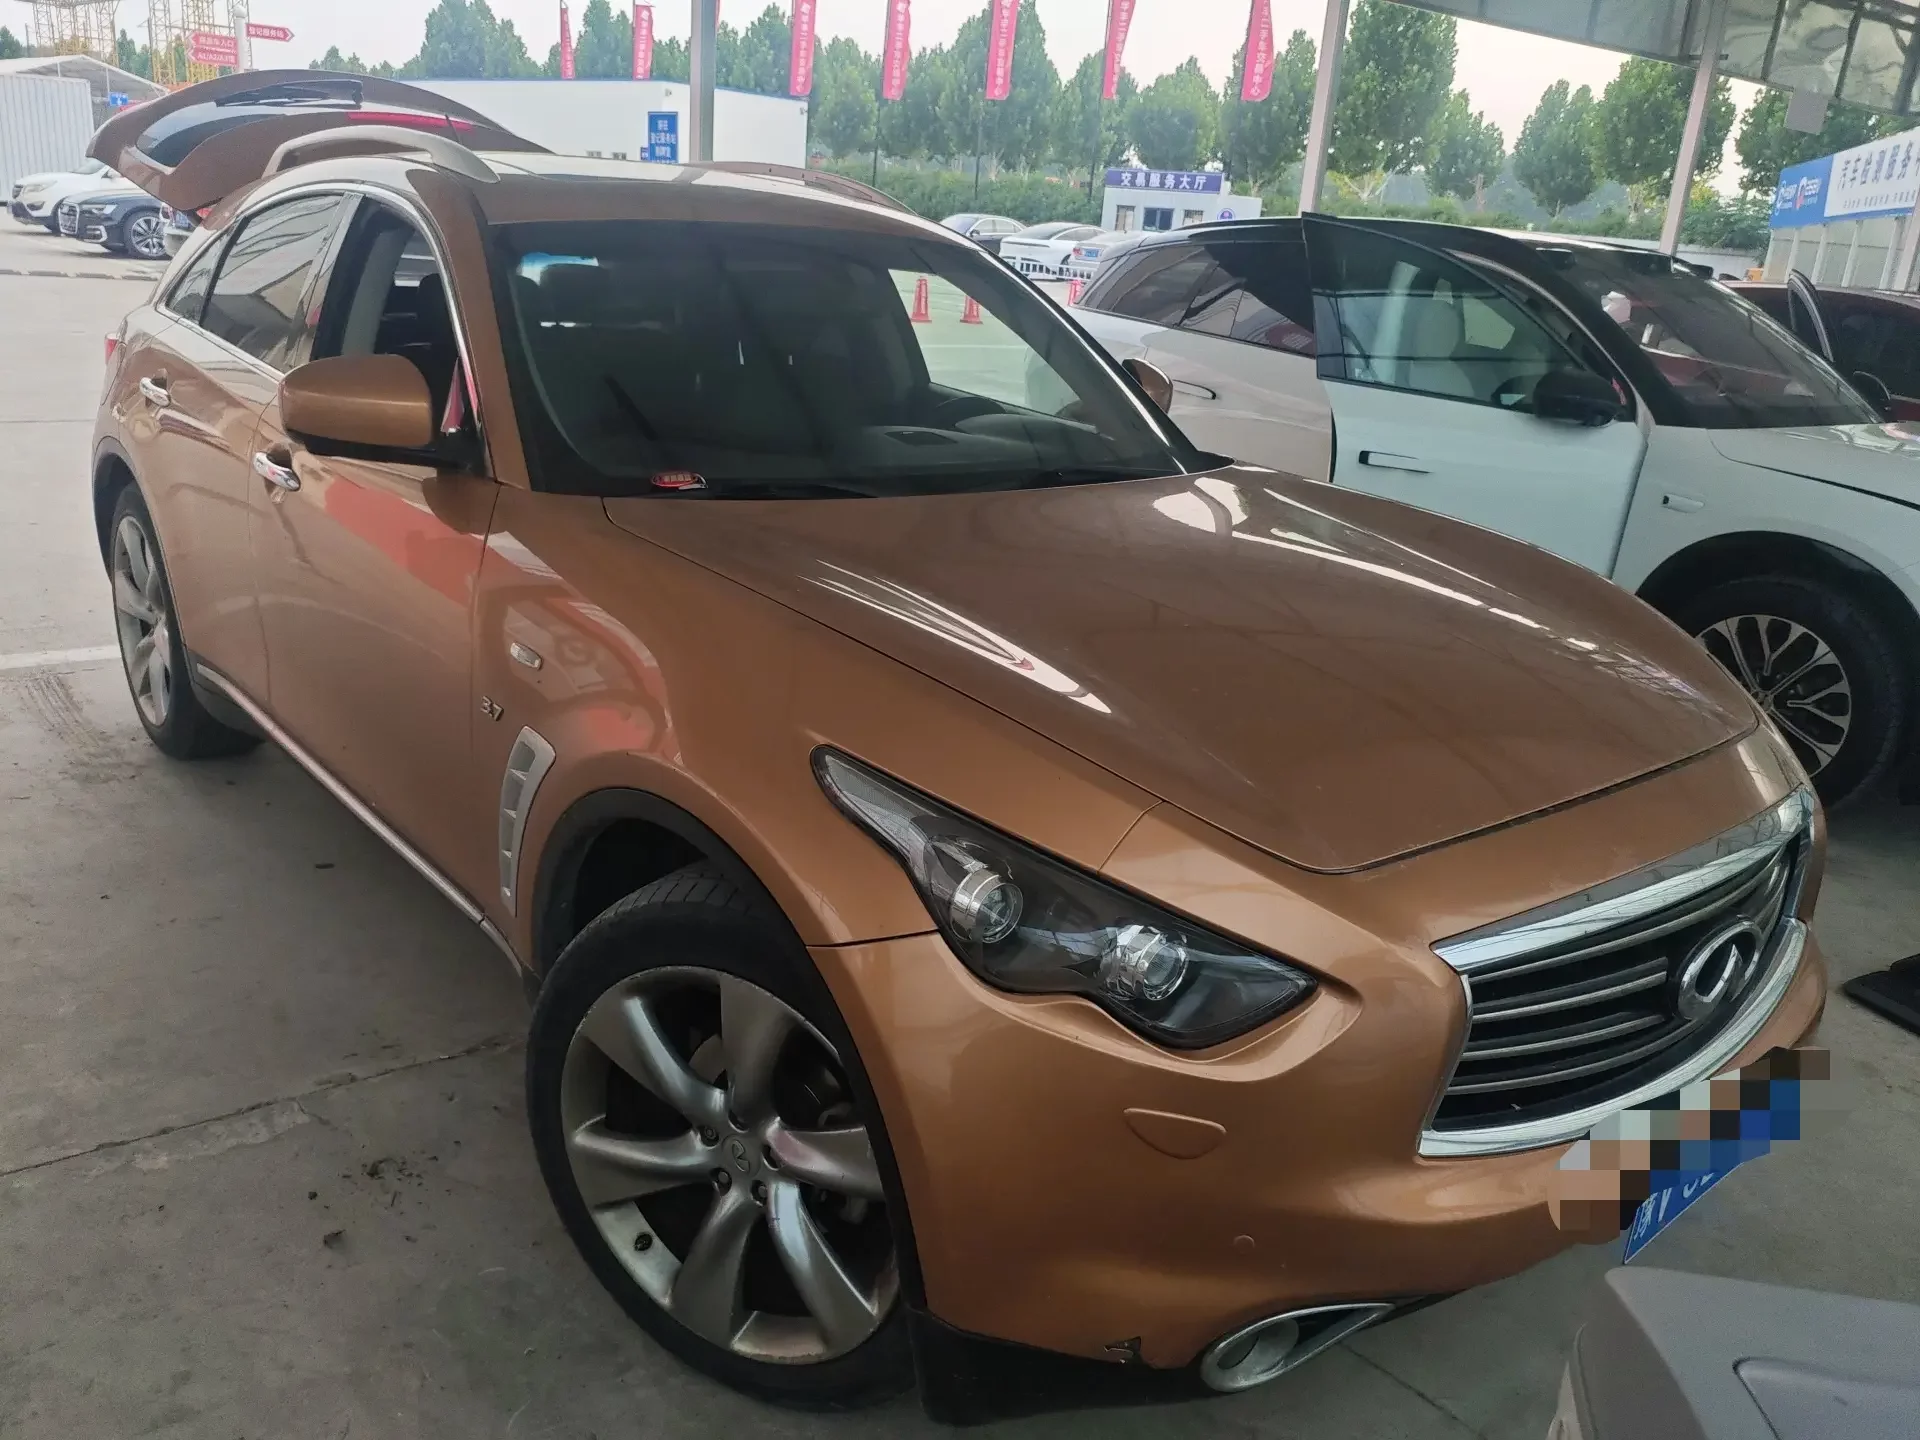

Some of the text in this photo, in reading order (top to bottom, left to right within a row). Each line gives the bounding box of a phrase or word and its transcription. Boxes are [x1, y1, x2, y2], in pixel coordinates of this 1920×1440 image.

[1120, 172, 1208, 191] 交易服务大厅
